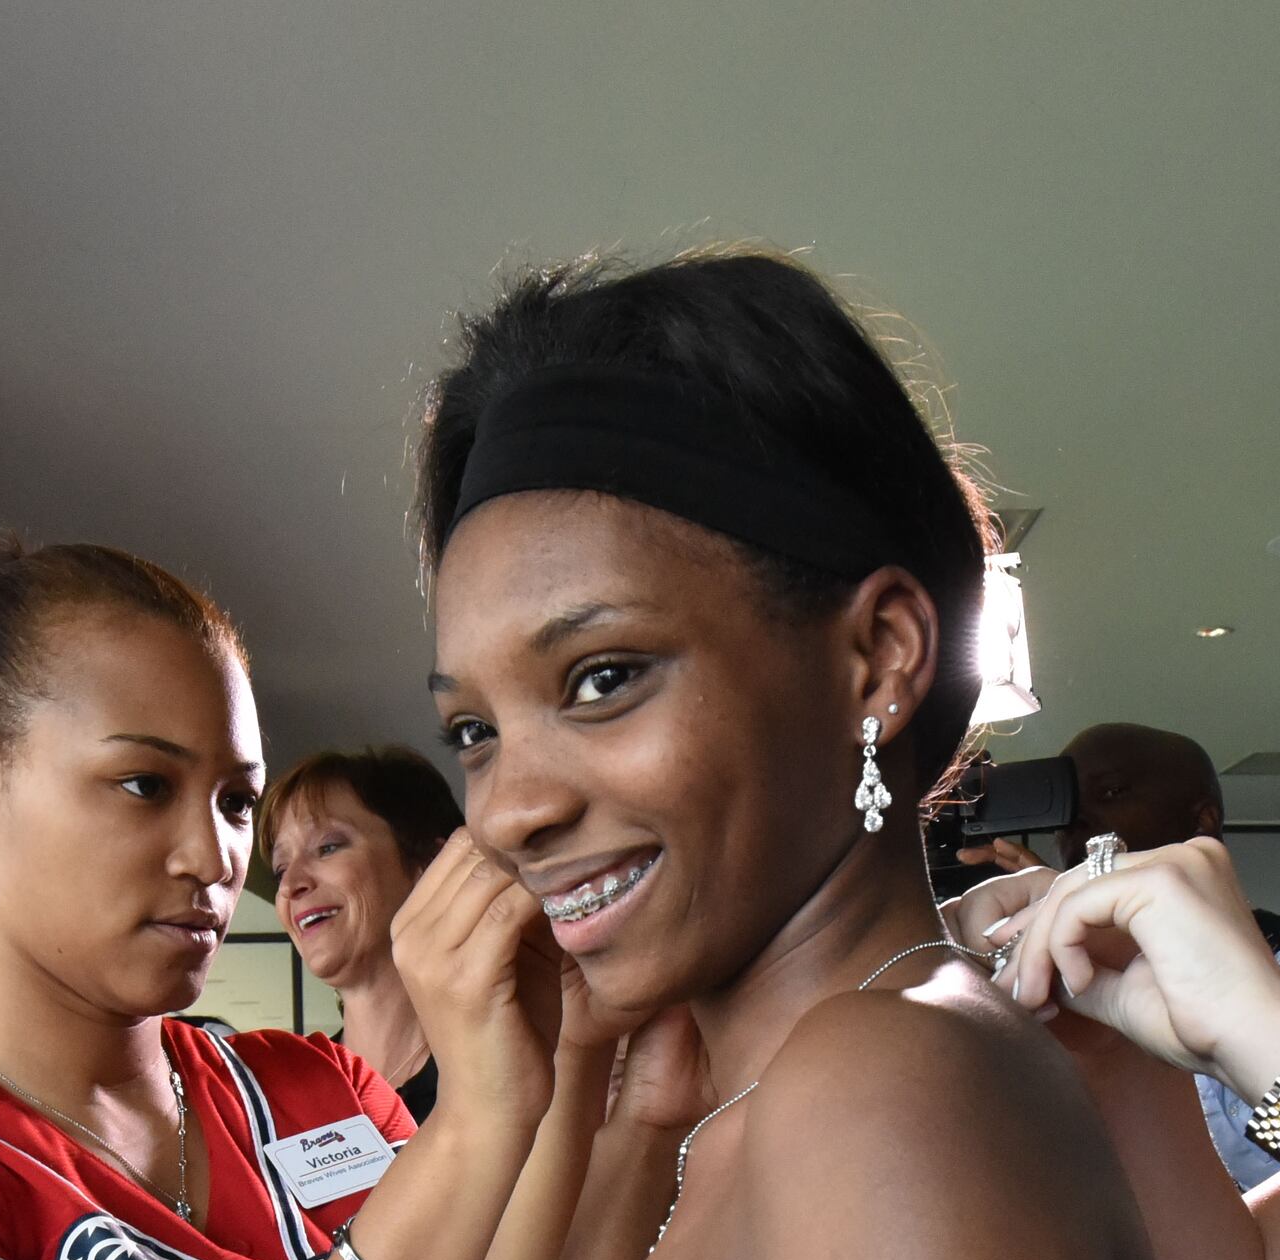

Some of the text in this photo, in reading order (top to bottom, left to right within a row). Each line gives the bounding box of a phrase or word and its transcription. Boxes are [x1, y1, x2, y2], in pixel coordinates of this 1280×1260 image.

[298, 1154, 387, 1188] Braves Wives Association
[306, 1145, 362, 1169] Victoria
